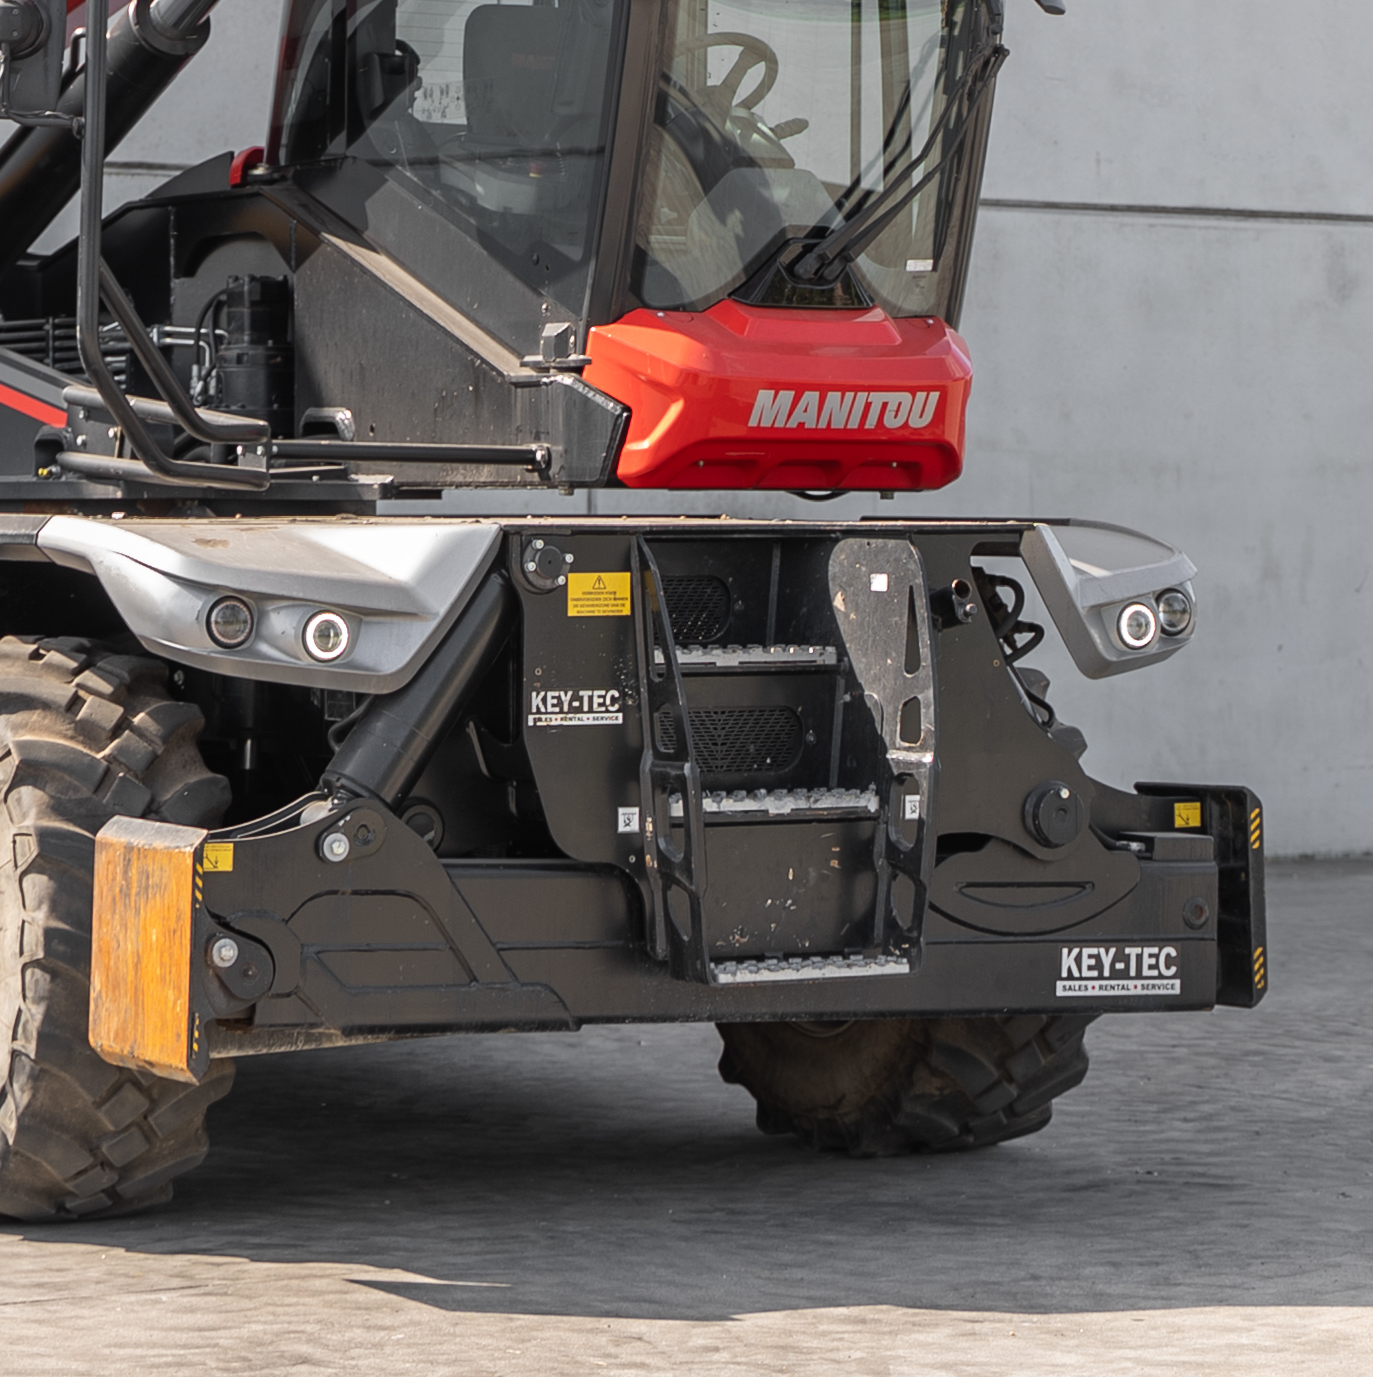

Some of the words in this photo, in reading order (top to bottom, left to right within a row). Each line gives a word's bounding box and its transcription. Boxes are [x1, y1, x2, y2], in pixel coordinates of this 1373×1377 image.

[747, 389, 941, 429] MANITOU
[531, 689, 620, 713] KEY-TEC
[1061, 946, 1178, 978] KEY-TEC
[1098, 984, 1131, 992] RENTAL
[1140, 983, 1176, 991] SERVICE
